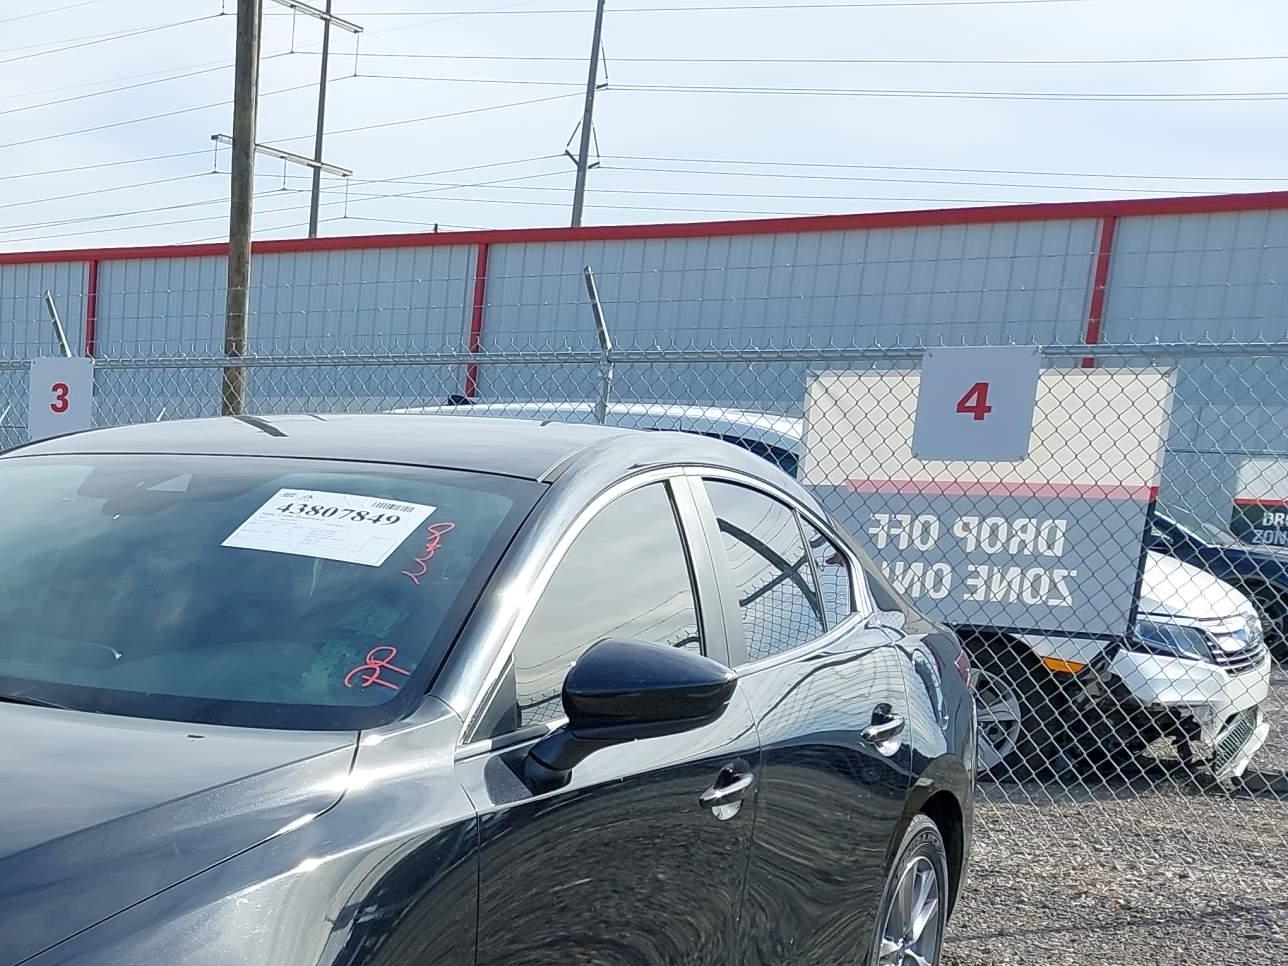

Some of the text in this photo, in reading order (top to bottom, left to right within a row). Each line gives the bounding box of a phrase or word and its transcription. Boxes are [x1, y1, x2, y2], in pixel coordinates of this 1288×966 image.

[50, 382, 70, 414] 3
[956, 381, 993, 421] 4
[277, 502, 401, 526] 43807849
[1262, 512, 1288, 527] DR
